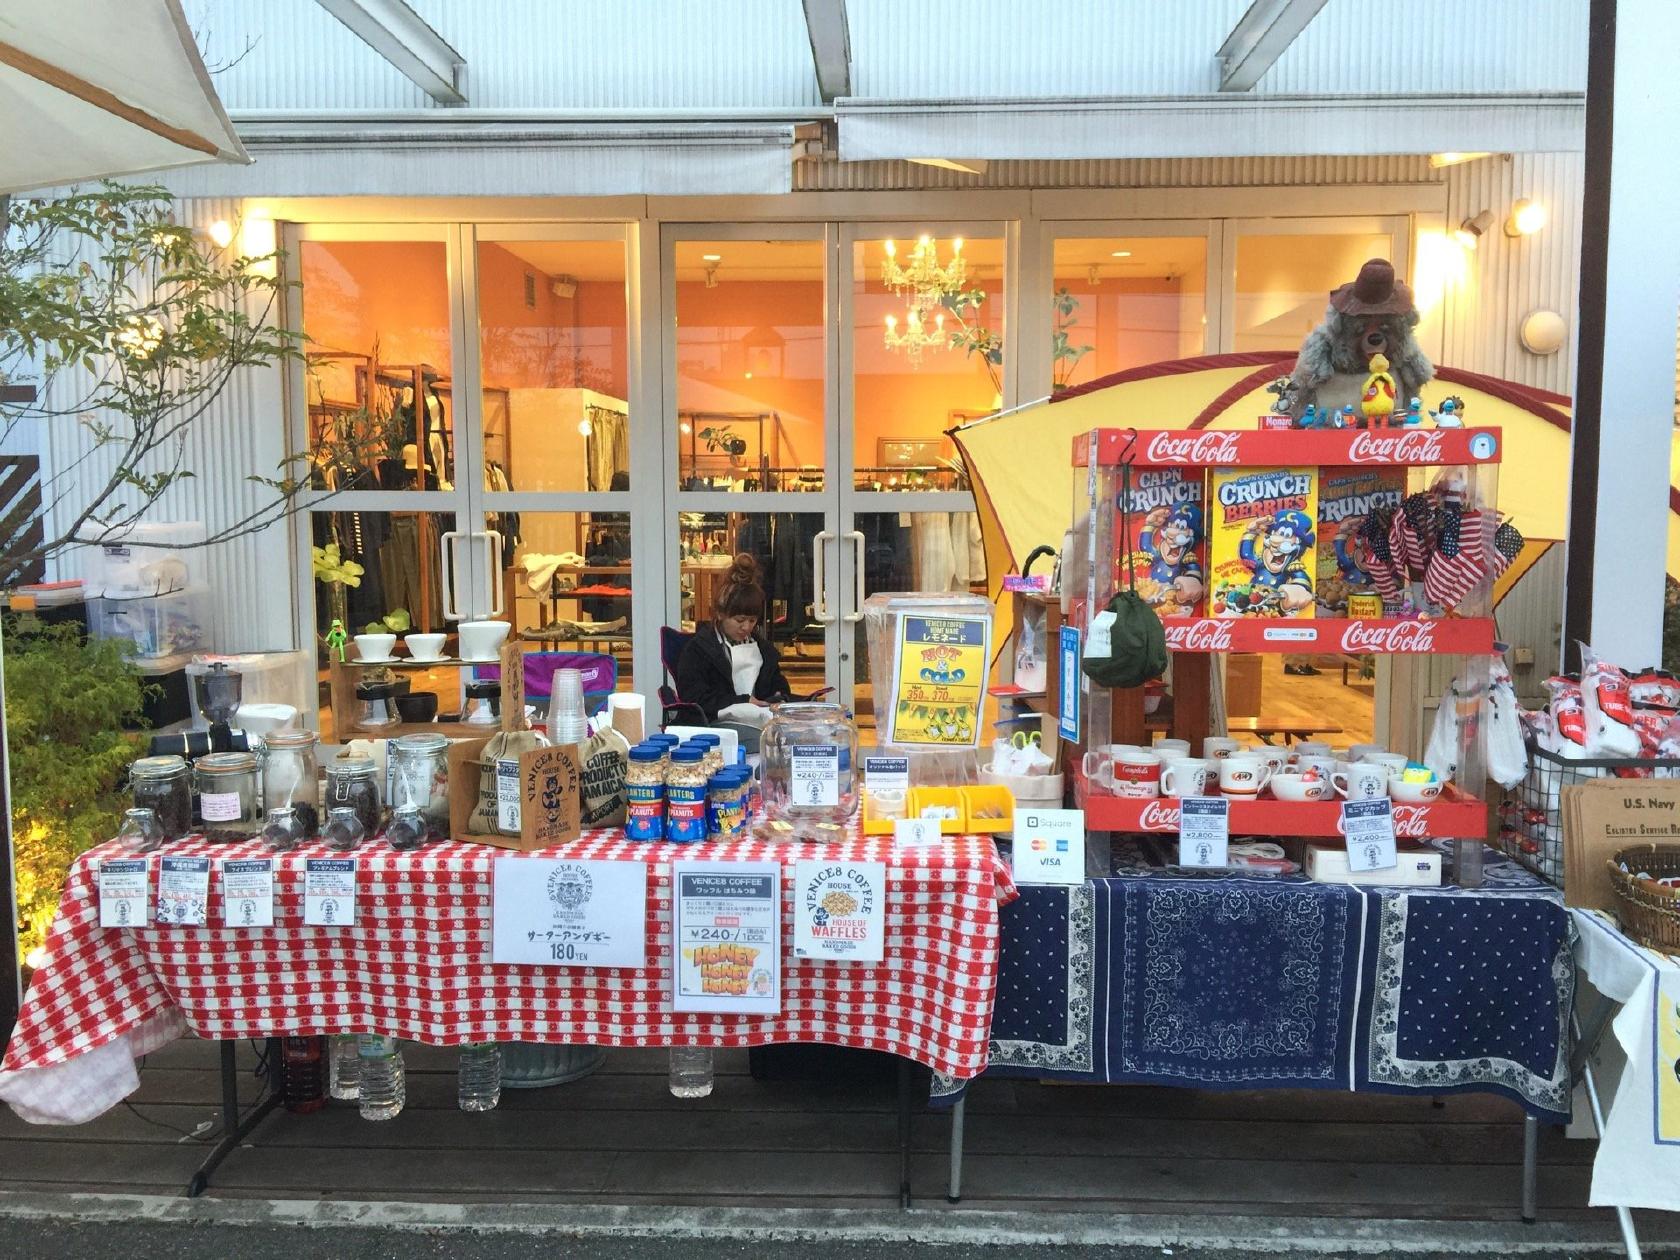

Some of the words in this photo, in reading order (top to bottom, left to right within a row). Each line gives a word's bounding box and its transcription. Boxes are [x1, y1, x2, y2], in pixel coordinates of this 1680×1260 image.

[1220, 475, 1311, 506] CRUNCH
[1224, 495, 1308, 524] BERRIES
[923, 633, 966, 643] レモネード
[921, 643, 962, 662] HOT
[920, 667, 965, 684] COLD
[556, 751, 577, 793] COFFEE
[630, 807, 655, 816] PEANUTS
[1623, 798, 1645, 809] U.S.
[1648, 798, 1675, 810] Navy
[1040, 818, 1072, 829] Square
[1040, 857, 1061, 866] VISA
[691, 878, 727, 886] VENICE8
[728, 878, 763, 886] COFFEE
[806, 866, 842, 912] VENICE8
[847, 869, 873, 915] COFFEE
[832, 919, 857, 927] HOUSE
[811, 926, 867, 939] WAFFLES
[550, 943, 575, 960] 180
[693, 943, 760, 968] HONEY
